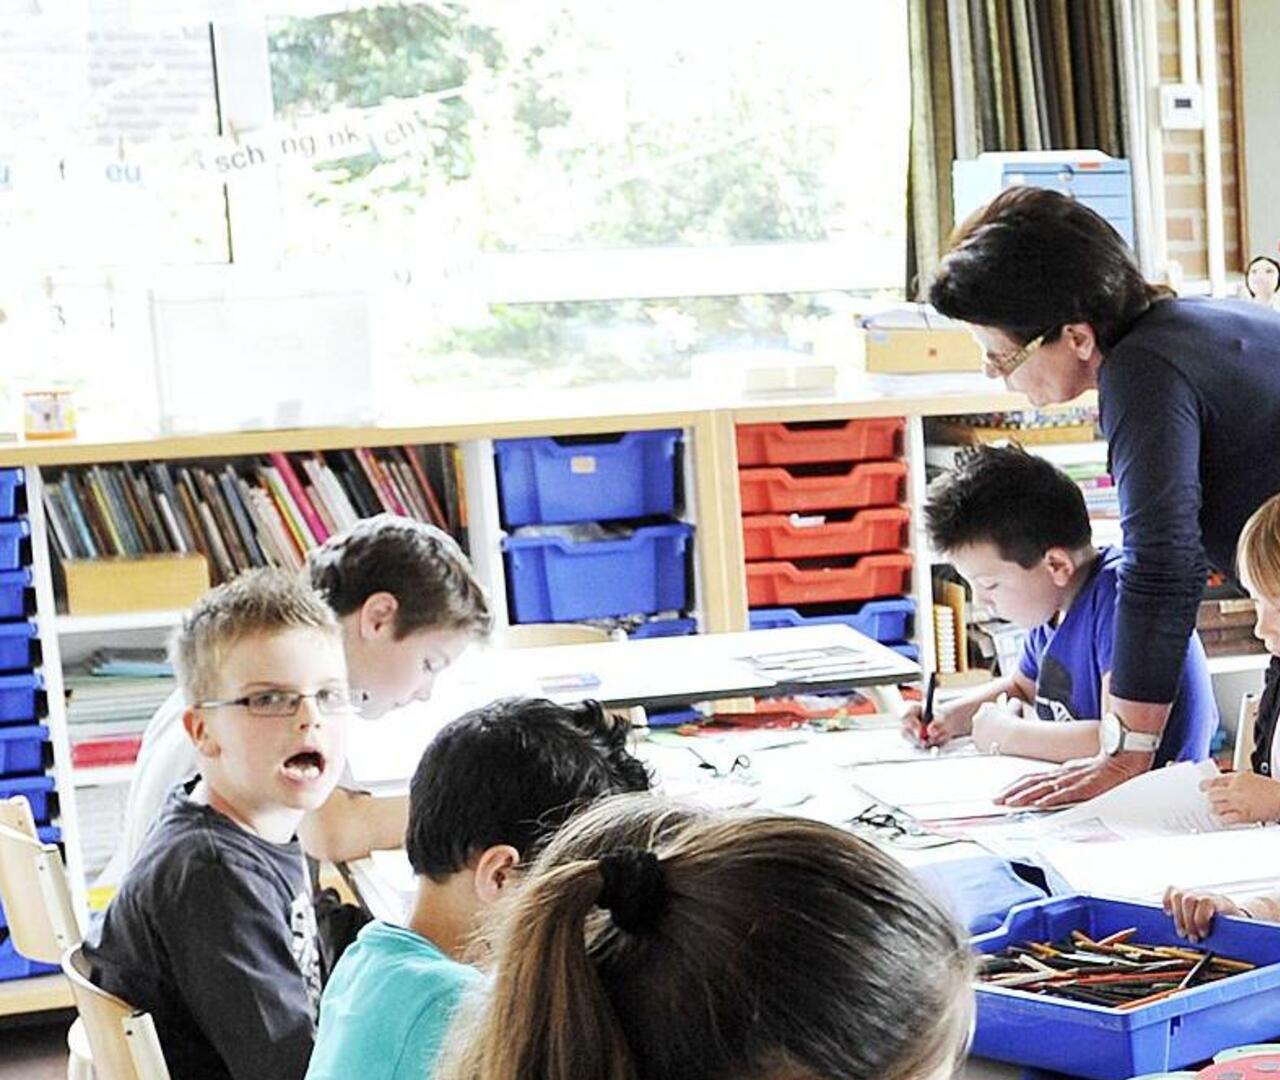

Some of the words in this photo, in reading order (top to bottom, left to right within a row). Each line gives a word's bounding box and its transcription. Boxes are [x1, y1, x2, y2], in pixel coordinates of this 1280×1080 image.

[214, 144, 265, 174] sch
[281, 135, 317, 158] ng
[105, 163, 142, 184] eu
